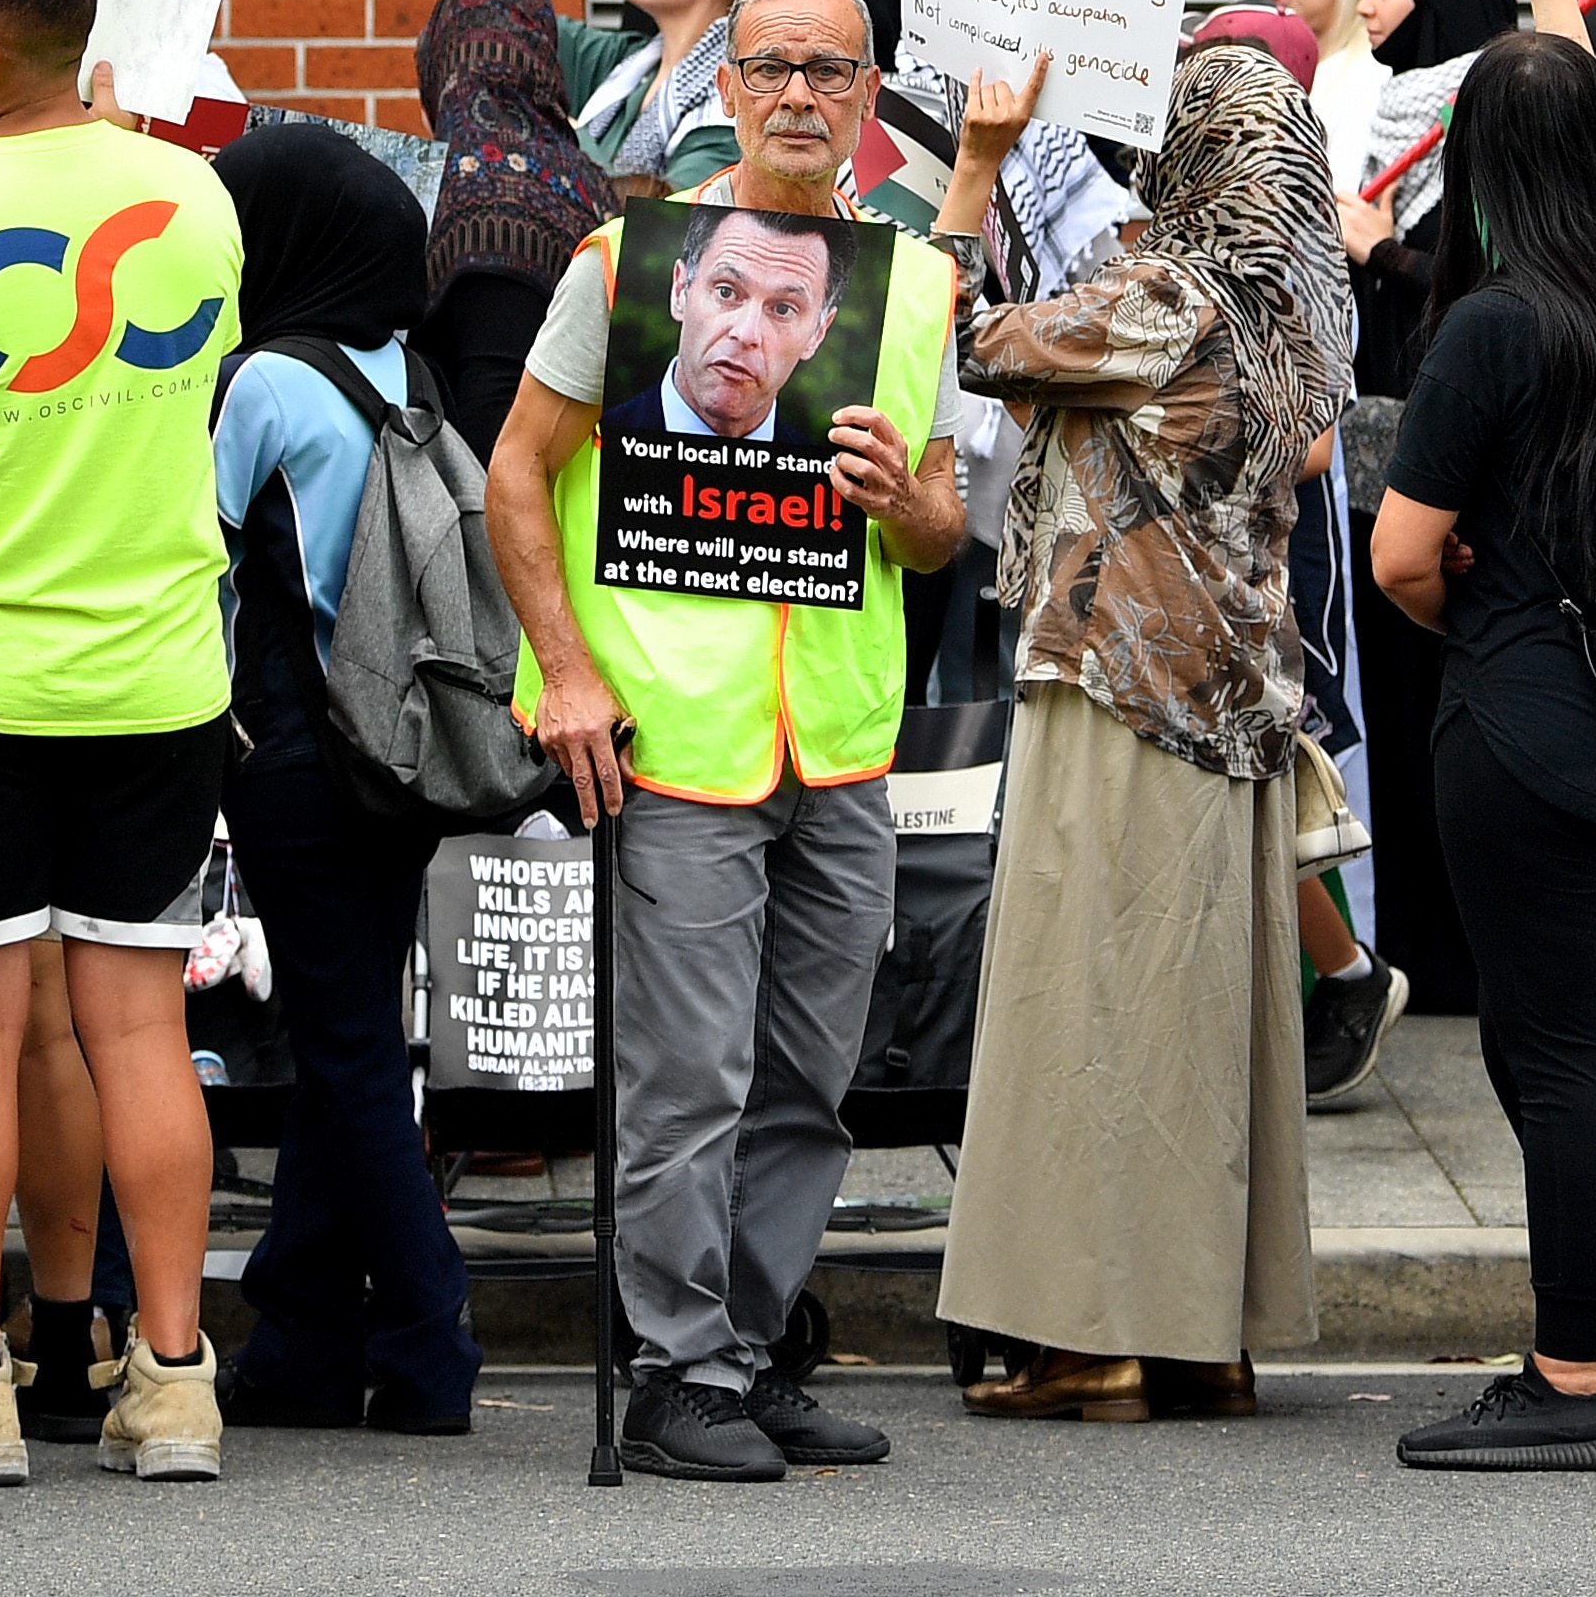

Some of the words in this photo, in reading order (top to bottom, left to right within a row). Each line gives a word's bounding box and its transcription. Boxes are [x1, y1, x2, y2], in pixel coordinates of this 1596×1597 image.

[1048, 0, 1128, 30] occupation
[948, 15, 1029, 62] complicated,
[1066, 52, 1151, 88] genocide
[621, 436, 672, 461] Your
[677, 441, 728, 466] local
[734, 448, 770, 468] MP
[776, 454, 837, 474] stand
[624, 493, 672, 515] with
[682, 473, 843, 532] Israel!
[617, 528, 689, 554] Where
[696, 537, 734, 558] will
[739, 544, 781, 565] you
[787, 549, 848, 569] stand
[604, 560, 630, 581] at
[636, 560, 677, 585] the
[684, 569, 740, 592] next
[747, 570, 859, 603] election?
[894, 808, 956, 829] LESTINE
[469, 855, 594, 887] WHOEVER
[478, 885, 551, 915] KILLS
[474, 913, 594, 943] INNOCEN
[457, 939, 518, 974] LIFE,
[524, 946, 551, 971] IT
[557, 946, 584, 971] IS
[477, 970, 501, 996] IF
[507, 974, 543, 1000] HE
[450, 994, 537, 1028] KILLED
[543, 1003, 594, 1028] ALL
[467, 1026, 594, 1057] HUMANIT
[467, 1054, 520, 1074] SURAH
[522, 1058, 594, 1075] AL-MA'ID
